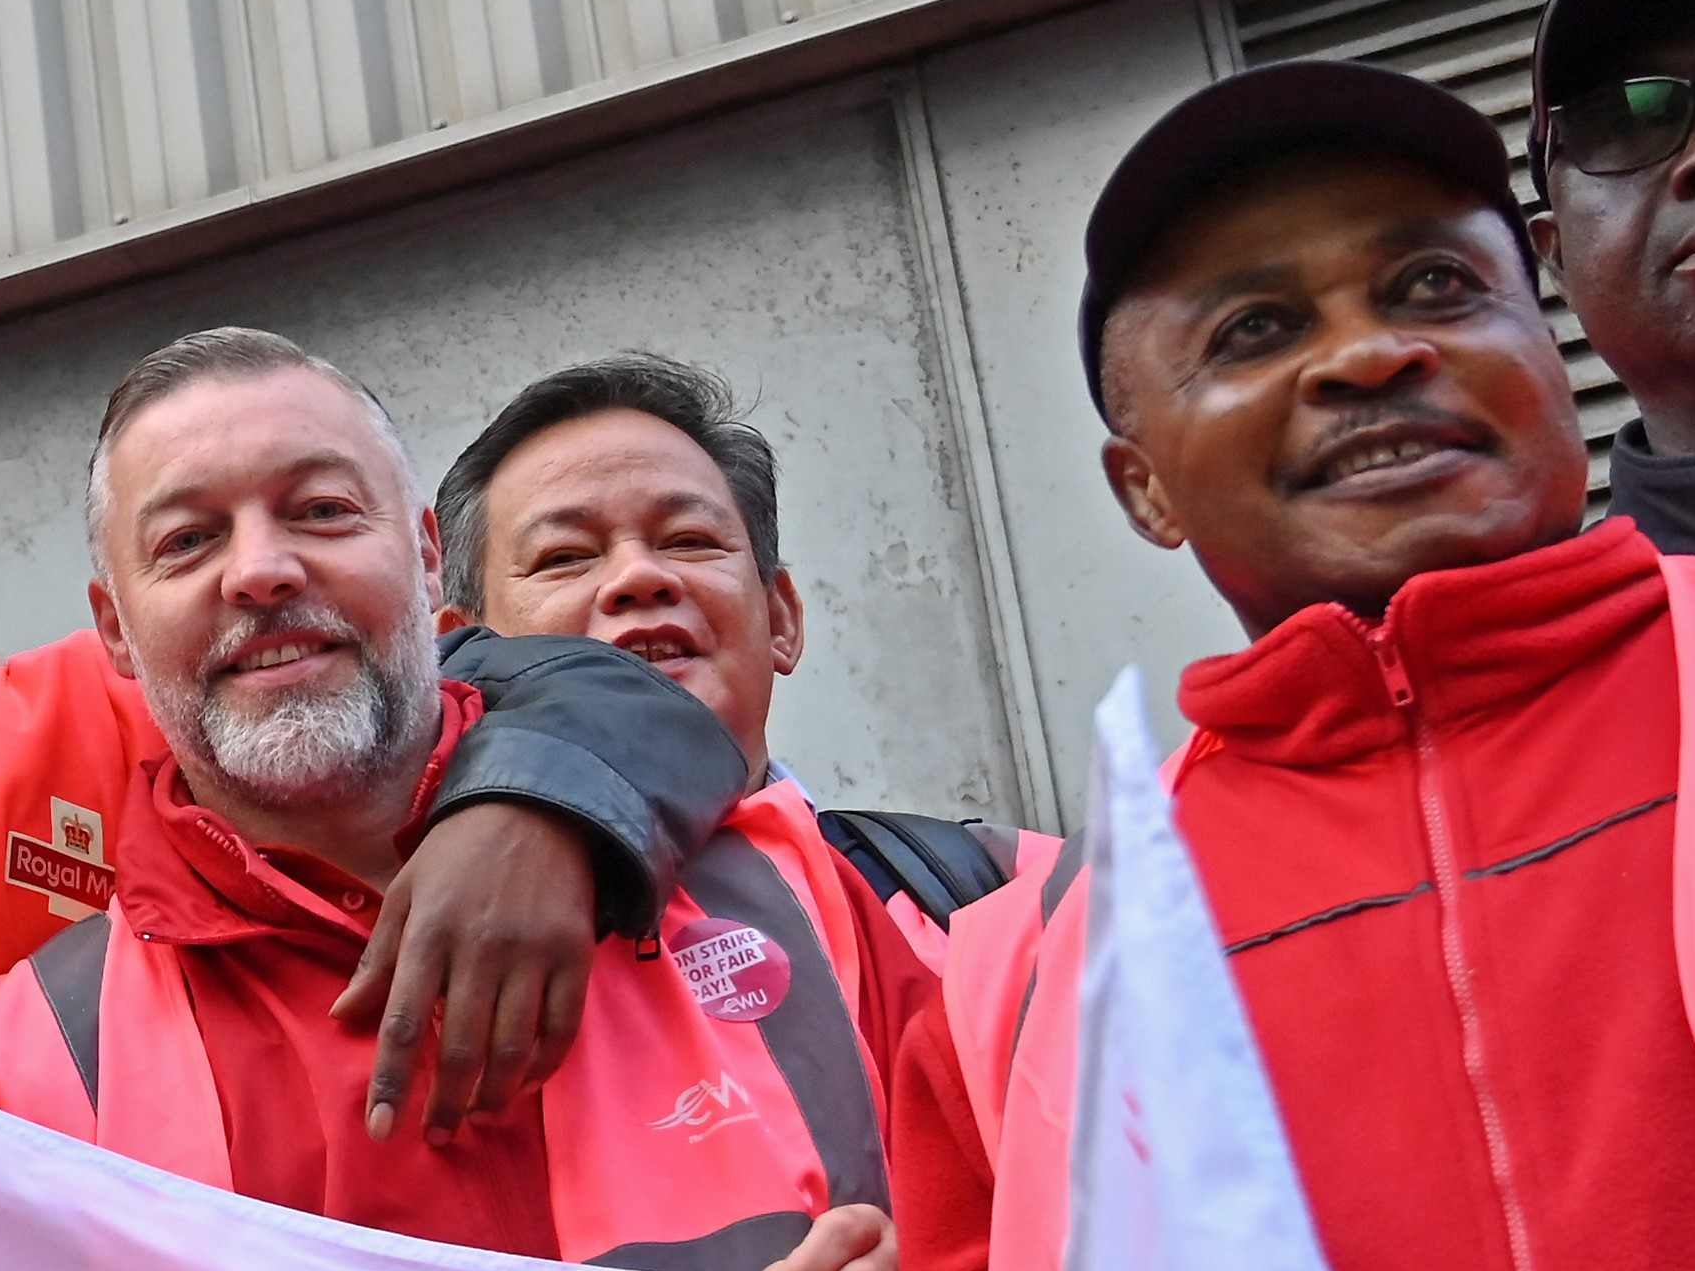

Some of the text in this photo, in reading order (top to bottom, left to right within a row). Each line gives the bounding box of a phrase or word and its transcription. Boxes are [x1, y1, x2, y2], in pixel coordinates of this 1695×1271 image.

[16, 844, 81, 890] Royal
[699, 930, 758, 959] STRIKE
[682, 947, 758, 983] OR FAIR
[714, 988, 768, 1014] CWU
